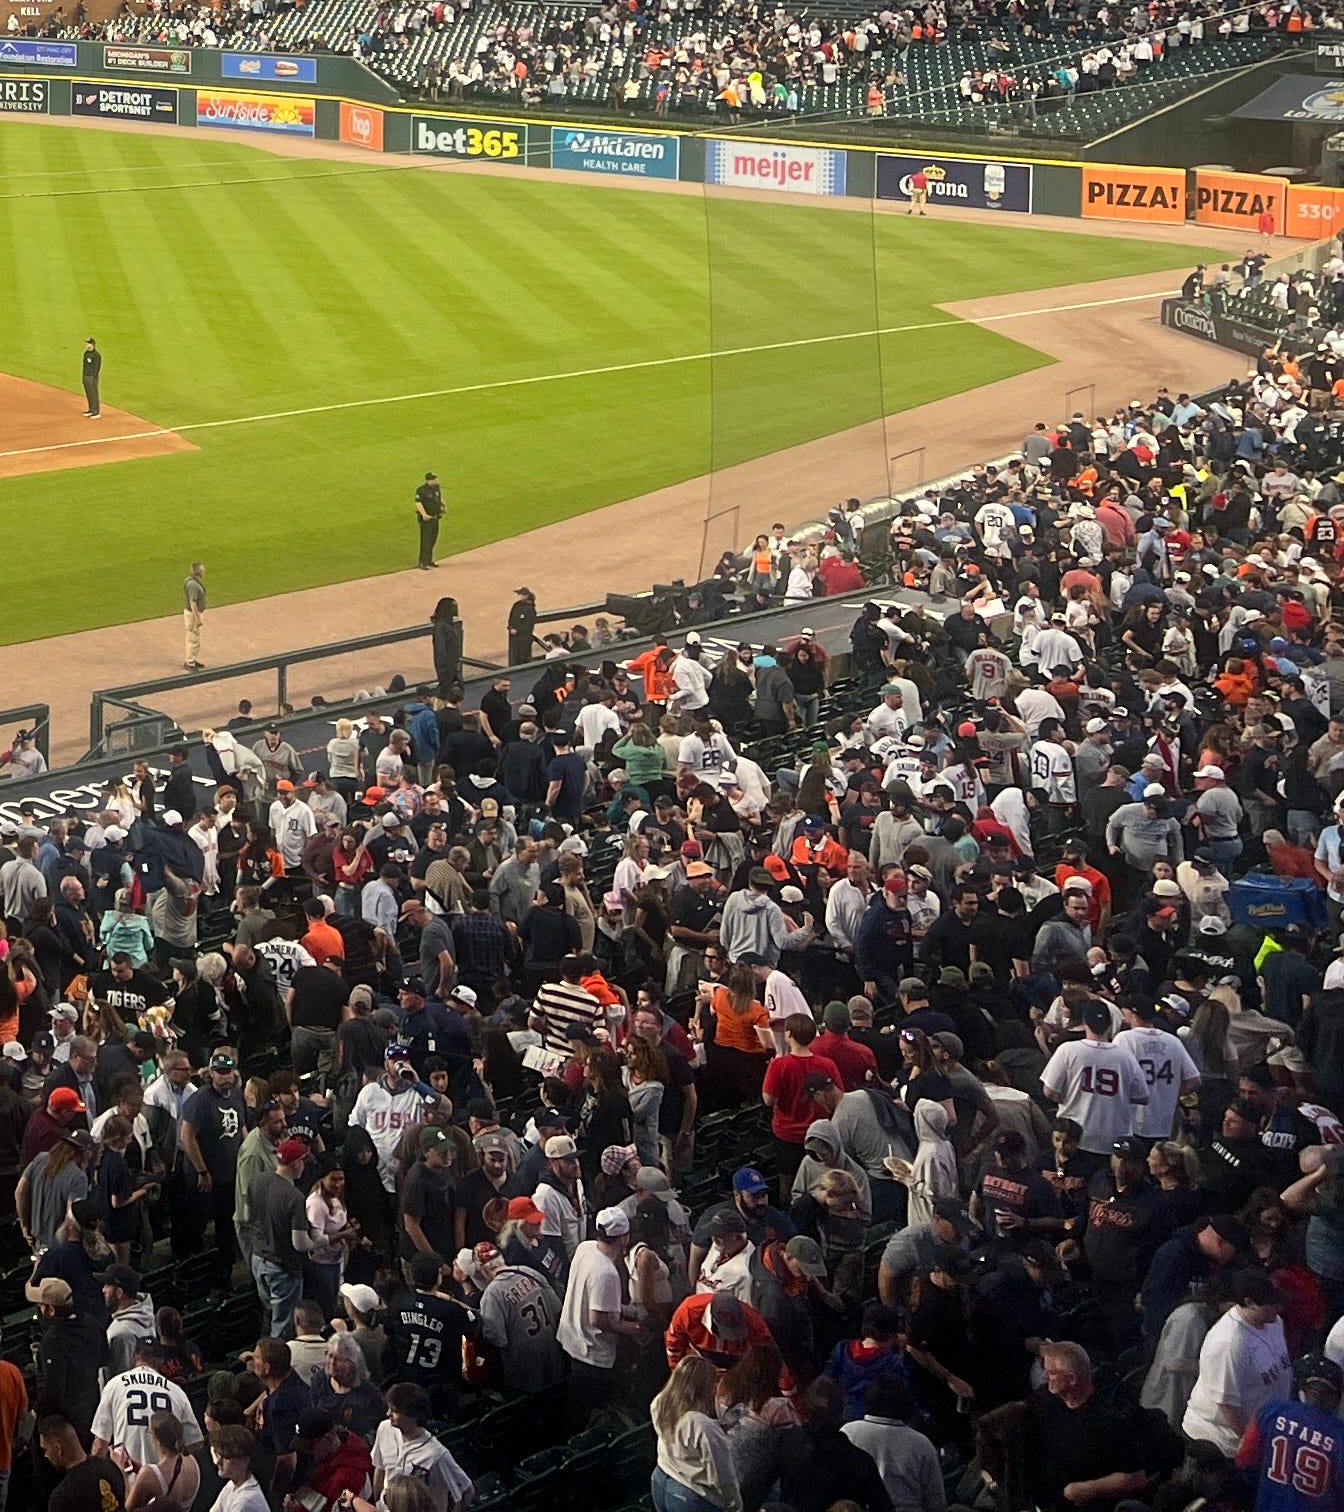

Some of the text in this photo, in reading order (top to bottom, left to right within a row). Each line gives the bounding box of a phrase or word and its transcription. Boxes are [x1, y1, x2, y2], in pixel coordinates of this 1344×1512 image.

[20, 6, 41, 16] KELL
[99, 90, 152, 106] DETROIT
[99, 103, 152, 116] SPORTSNET
[206, 98, 270, 122] Surfside
[418, 122, 518, 158] bet365
[591, 138, 664, 161] McLaren
[583, 158, 646, 174] HEALTH CARE
[733, 151, 814, 186] meijer
[899, 174, 968, 198] Crona
[1088, 182, 1178, 210] PIZZA!
[987, 516, 1002, 529] 20
[982, 663, 995, 679] 9
[107, 990, 146, 1011] TIGERS
[1080, 1066, 1120, 1096] 19
[401, 1310, 444, 1334] DINGLER
[520, 1297, 551, 1336] 31
[407, 1333, 443, 1369] 13
[121, 1374, 172, 1392] SKUBAL
[126, 1389, 172, 1426] 29
[1276, 1415, 1334, 1452] STARS
[1268, 1434, 1331, 1498] 19
